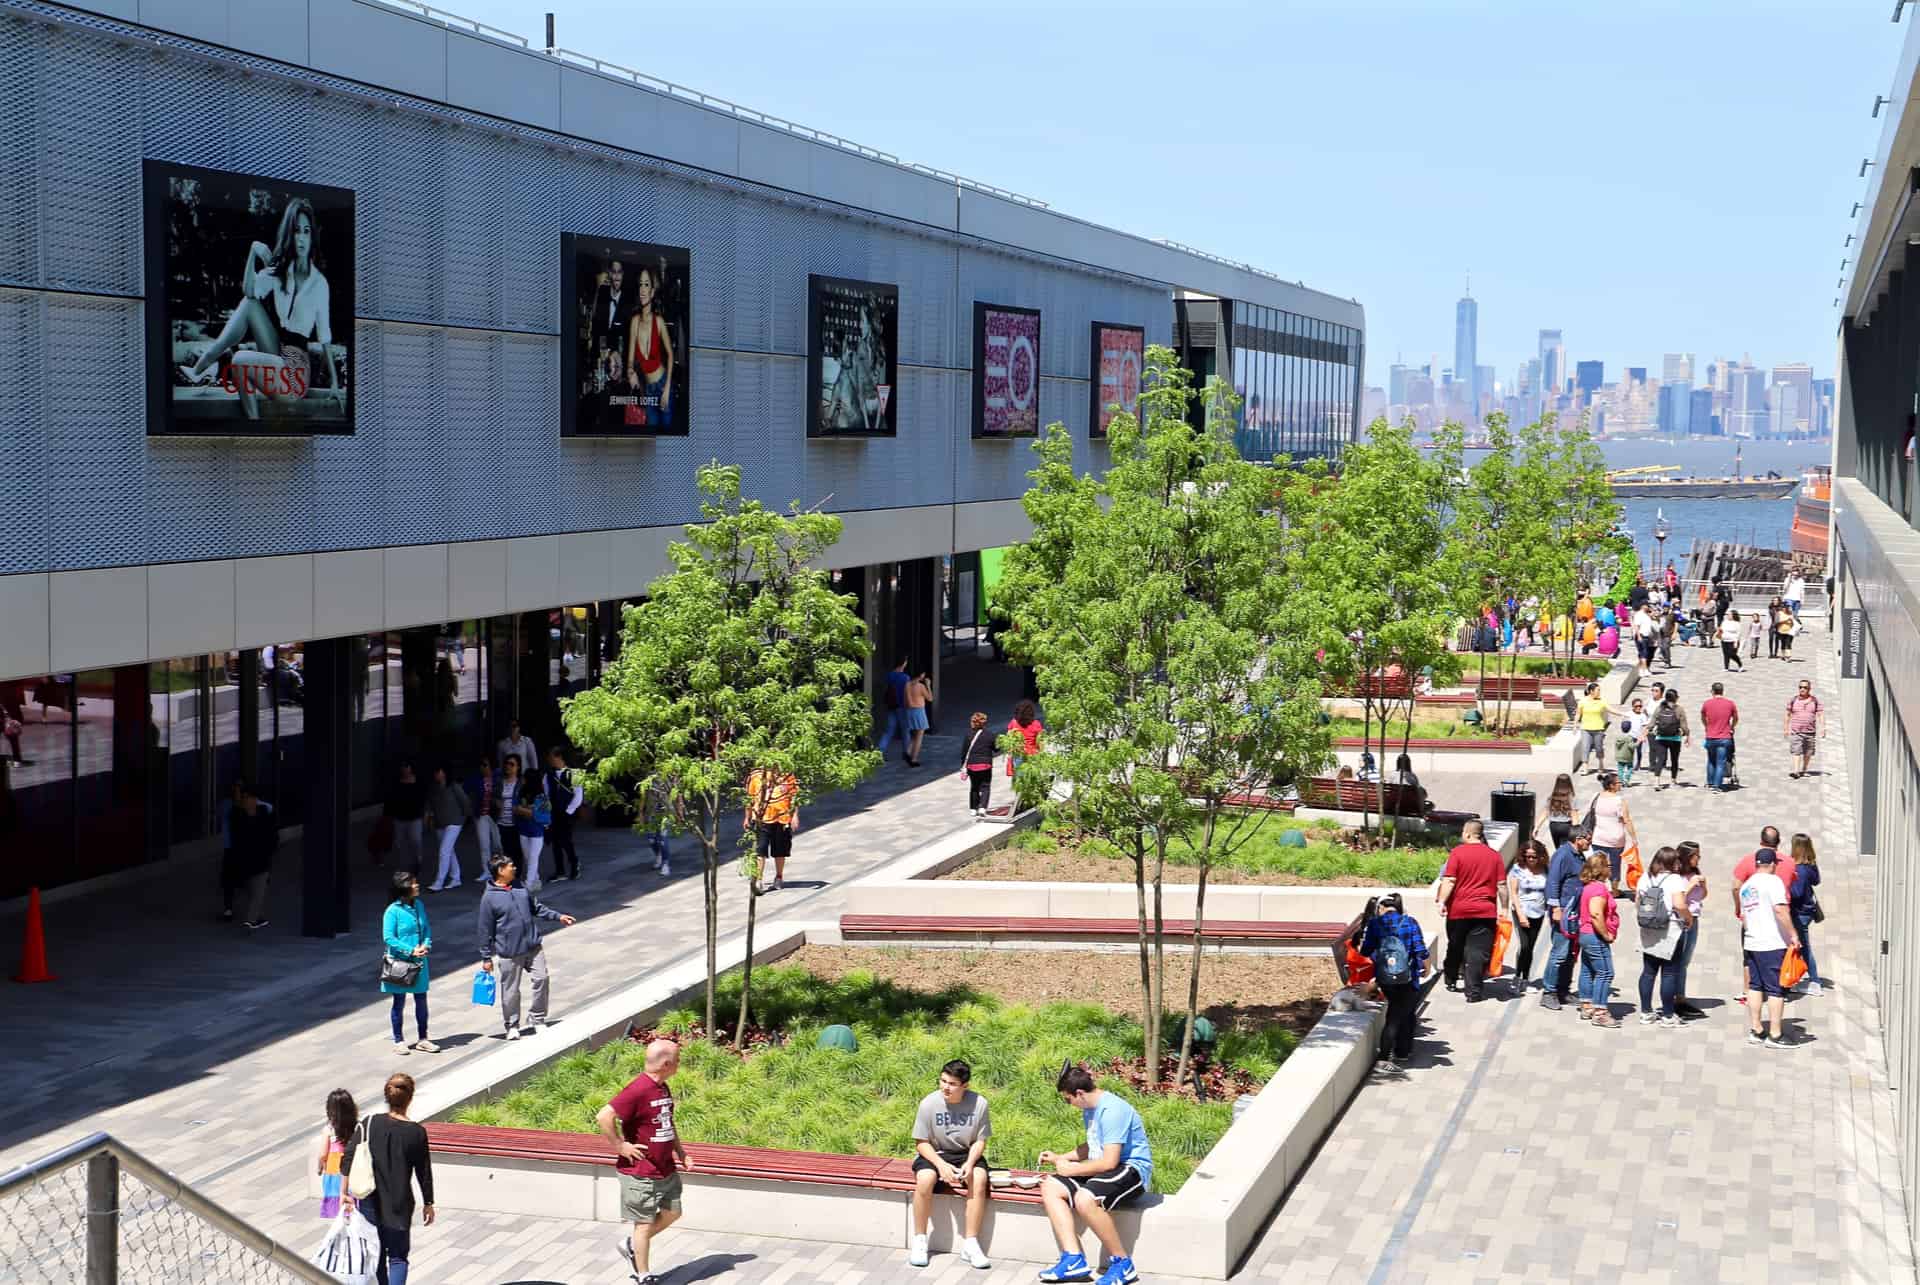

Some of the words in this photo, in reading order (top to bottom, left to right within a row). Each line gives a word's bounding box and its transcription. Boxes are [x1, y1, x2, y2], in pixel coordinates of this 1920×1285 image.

[220, 363, 306, 398] GUESS
[609, 395, 638, 406] JENNIFER
[639, 396, 660, 407] LOPEZ
[935, 1111, 976, 1127] BEAST
